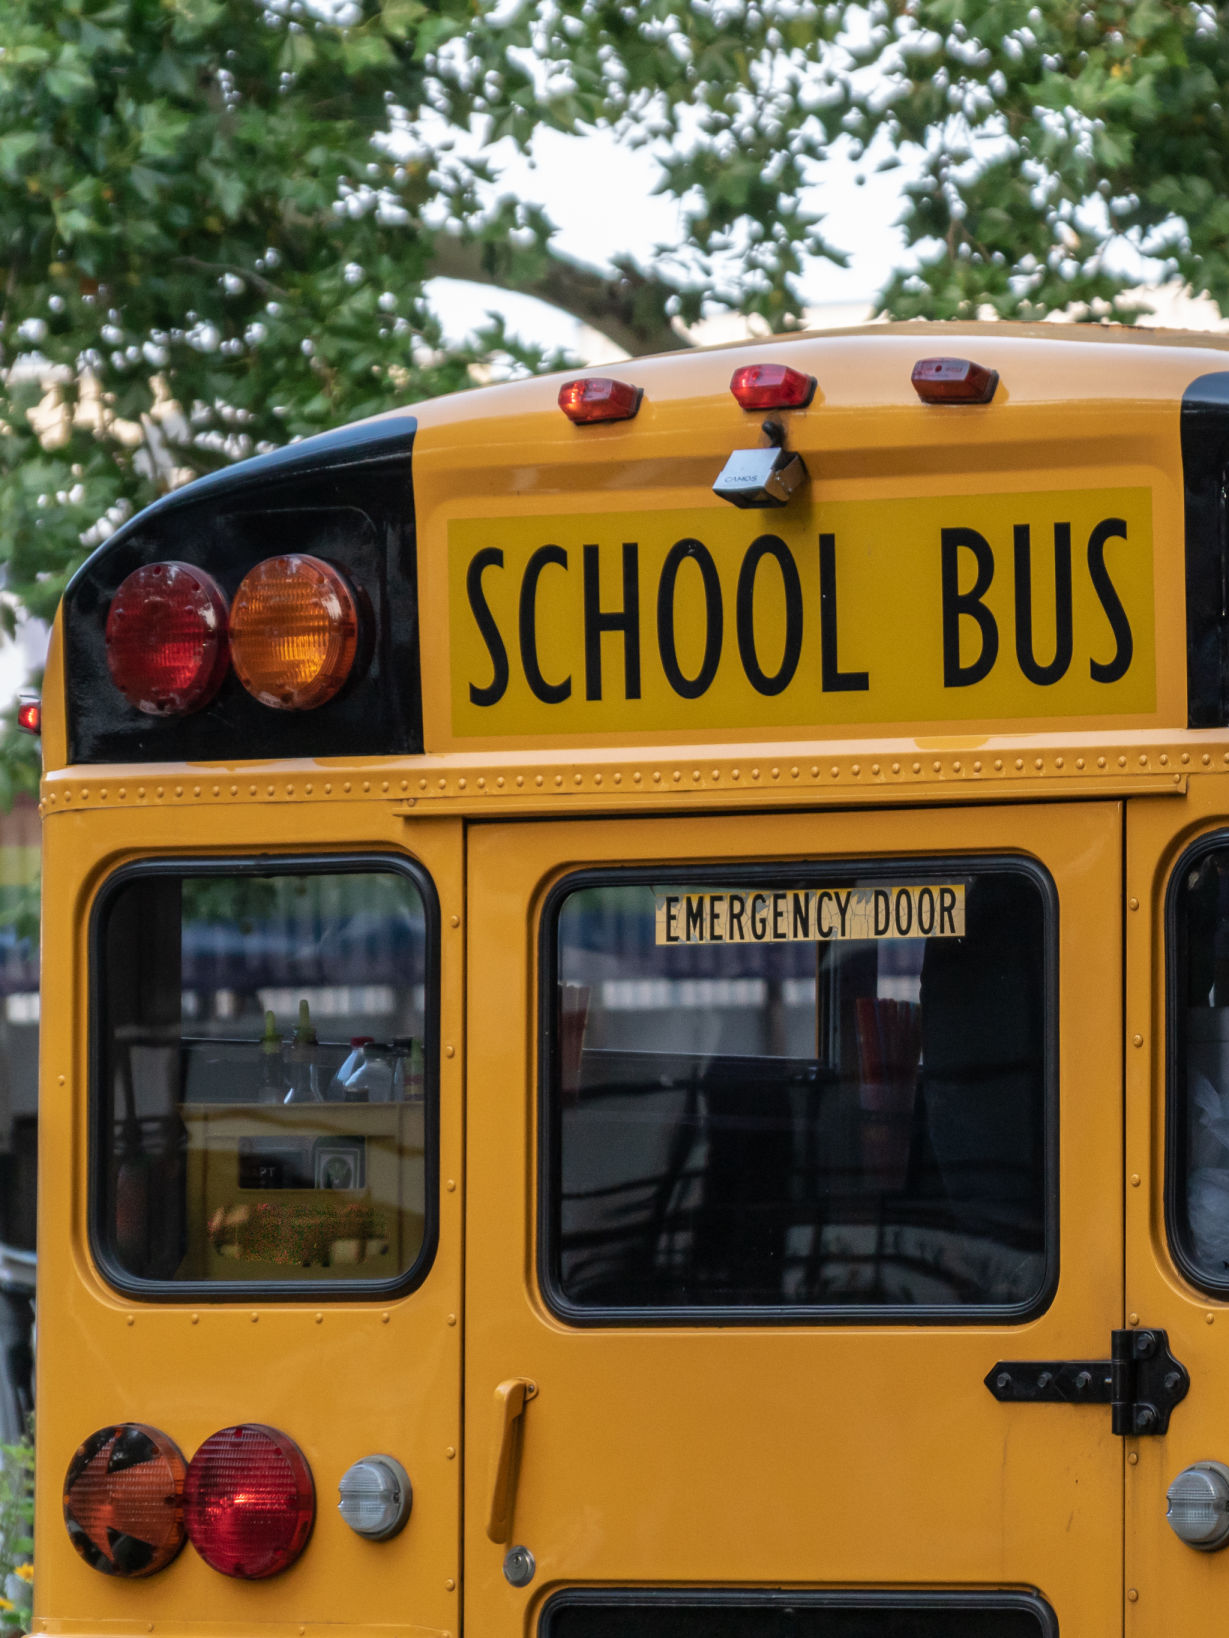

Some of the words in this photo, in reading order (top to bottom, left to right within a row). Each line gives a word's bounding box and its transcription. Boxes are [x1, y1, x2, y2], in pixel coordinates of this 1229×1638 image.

[466, 533, 870, 707] SCHOOL
[940, 517, 1134, 688] BUS
[665, 890, 851, 942] EMERGENCY
[874, 887, 956, 936] DOOR
